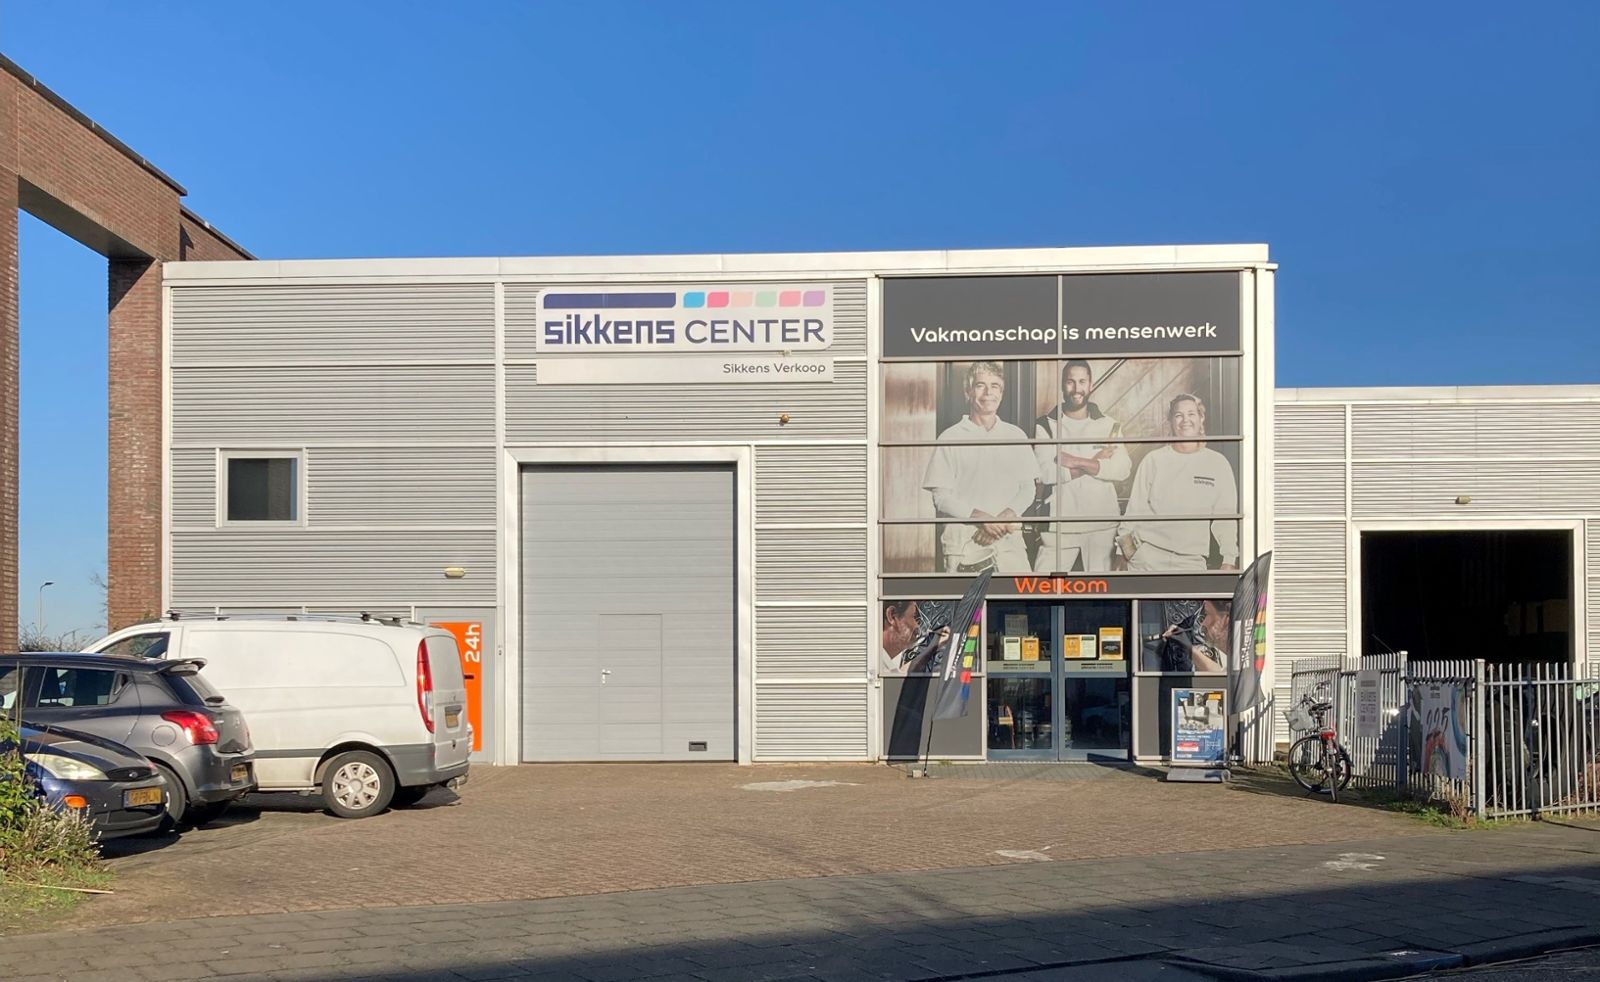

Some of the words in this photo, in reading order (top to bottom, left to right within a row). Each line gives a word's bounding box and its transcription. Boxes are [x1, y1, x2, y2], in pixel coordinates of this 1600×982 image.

[545, 314, 675, 344] sikkens
[684, 319, 825, 344] CENTER
[910, 326, 1057, 344] Vakmanschap
[1062, 325, 1080, 340] is
[1085, 322, 1217, 340] mensenwerk
[723, 363, 770, 374] Sikkens
[774, 363, 826, 375] Verkoop
[1014, 576, 1108, 593] Welkom
[464, 623, 480, 663] 24h
